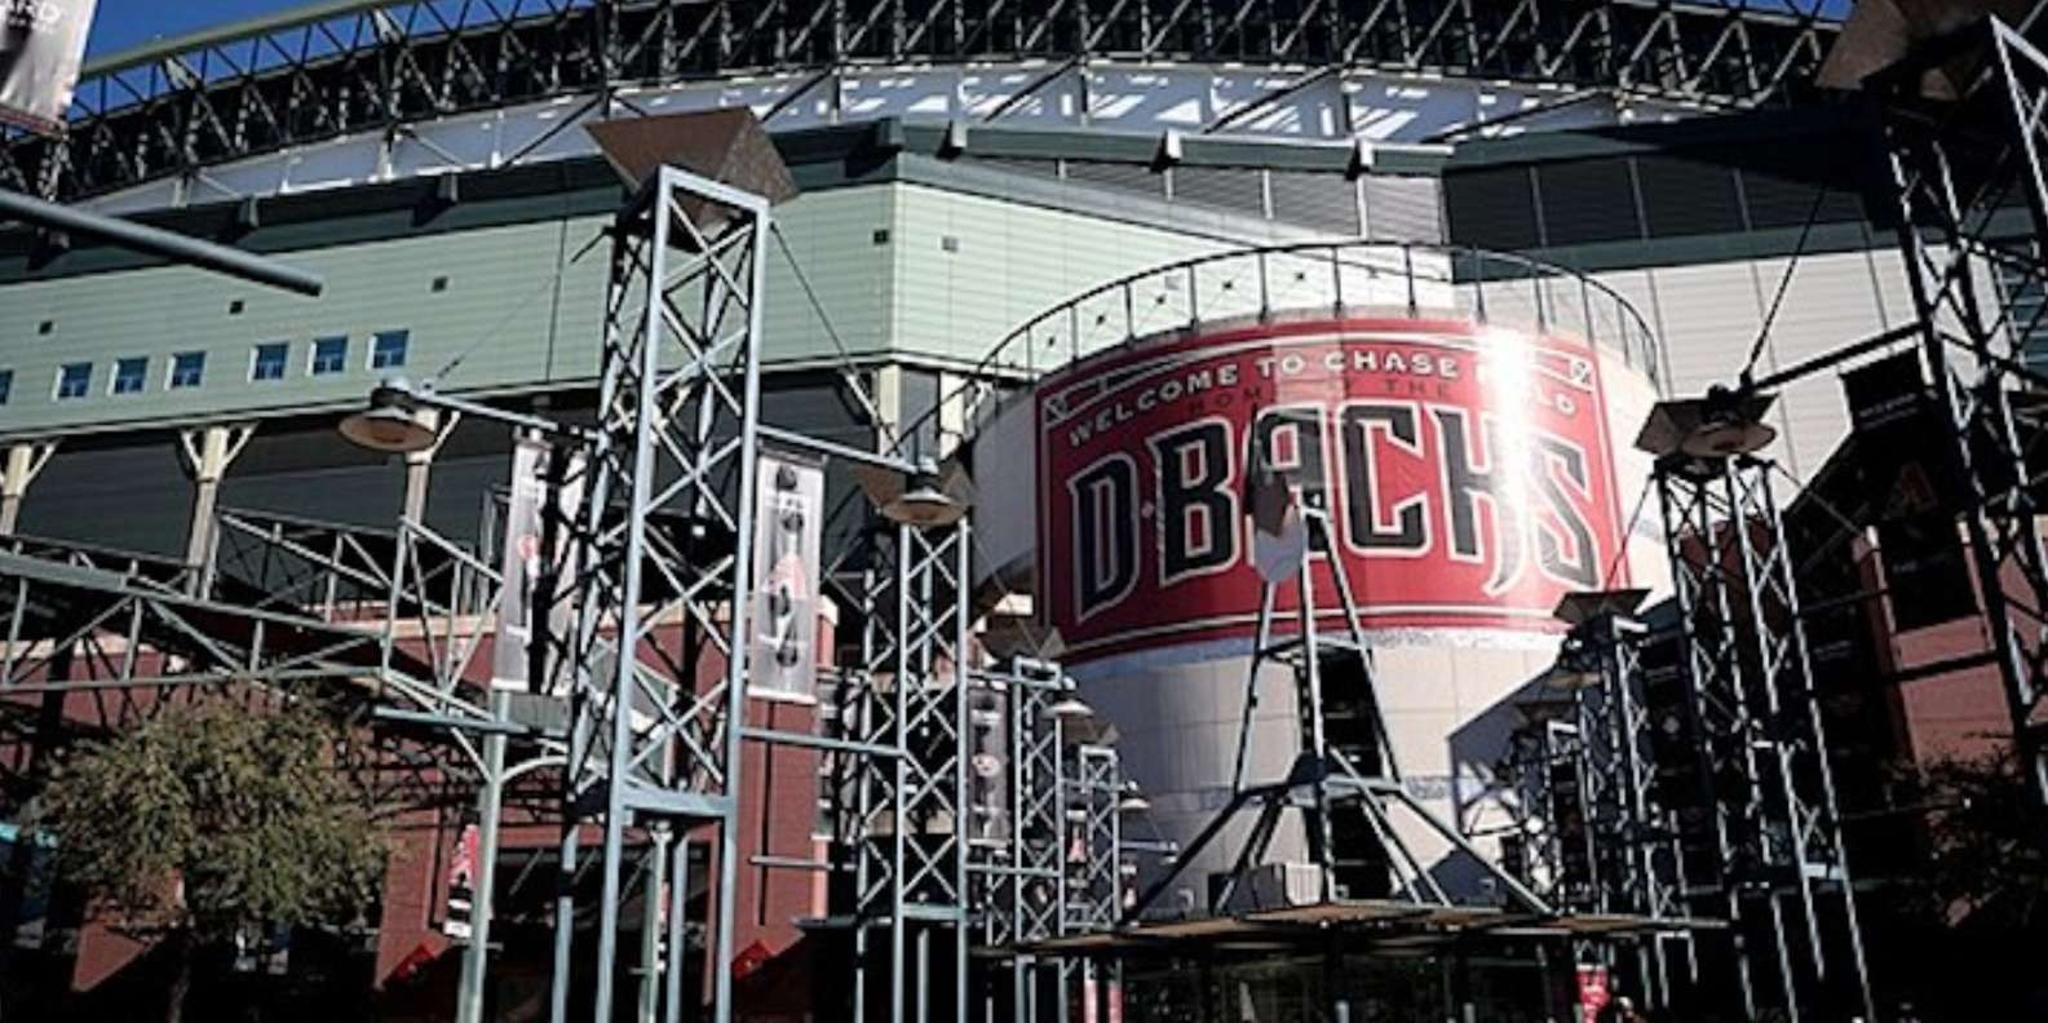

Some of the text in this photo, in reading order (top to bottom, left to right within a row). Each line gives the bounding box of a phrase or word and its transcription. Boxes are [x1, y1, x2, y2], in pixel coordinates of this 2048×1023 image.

[1069, 363, 1239, 447] WELCOME
[1255, 353, 1306, 378] TO
[1323, 350, 1459, 379] CHASE
